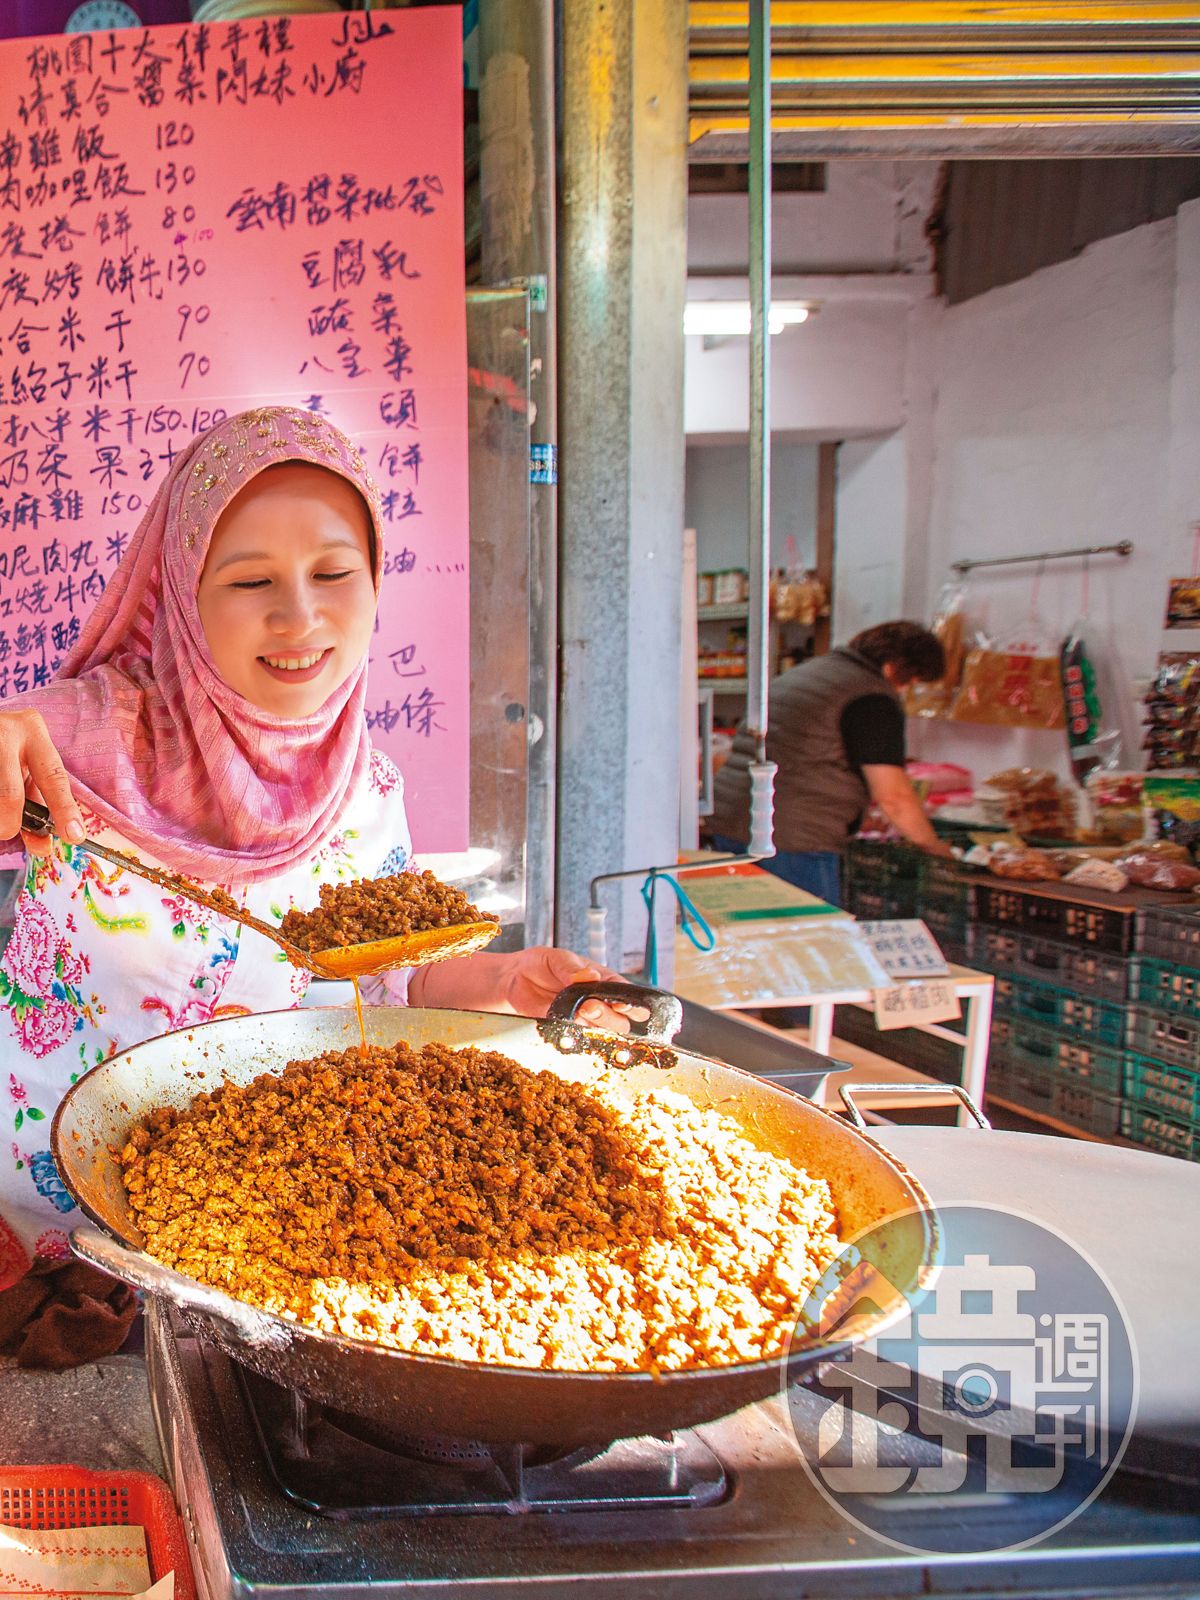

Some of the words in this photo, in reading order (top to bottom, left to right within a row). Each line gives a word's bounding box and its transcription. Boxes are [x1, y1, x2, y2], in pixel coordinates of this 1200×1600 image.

[156, 121, 195, 150] 120
[156, 162, 196, 194] 130
[162, 205, 195, 229] 80
[168, 254, 206, 285] 130
[302, 239, 422, 292] 豆腐乳
[178, 304, 210, 341] 90
[179, 352, 210, 389] 70
